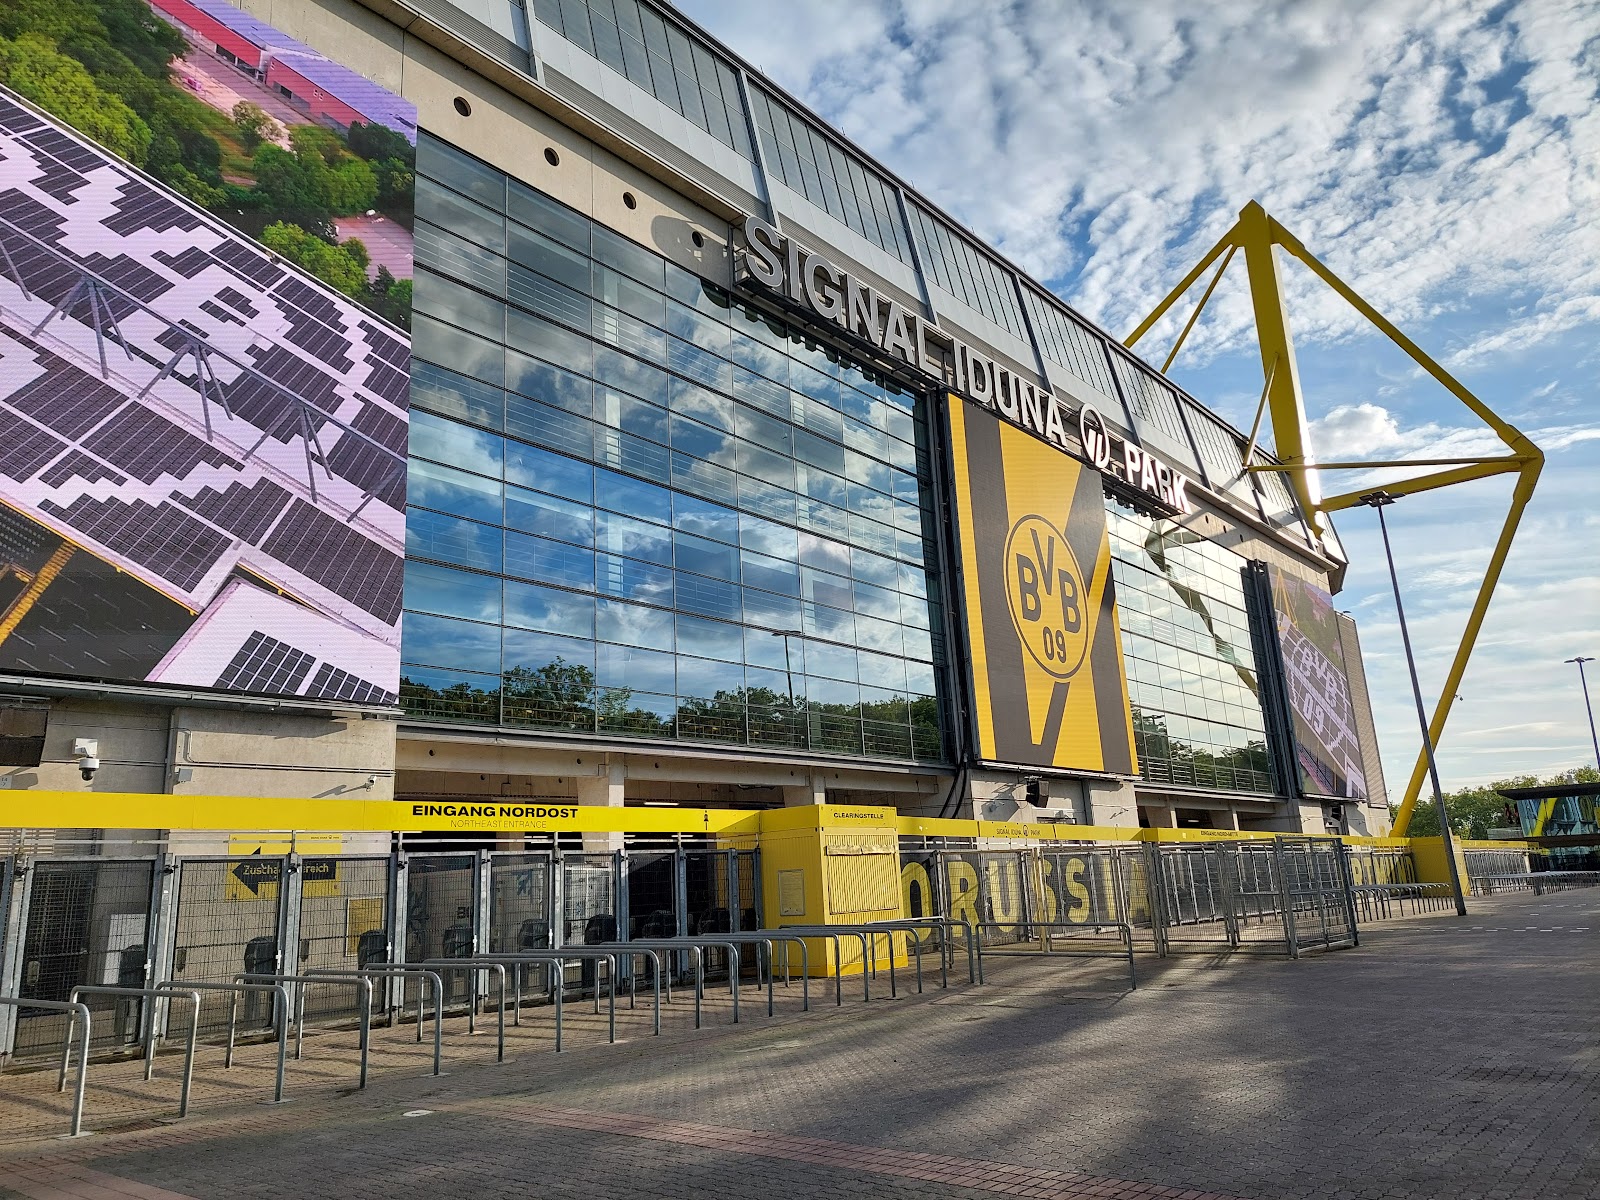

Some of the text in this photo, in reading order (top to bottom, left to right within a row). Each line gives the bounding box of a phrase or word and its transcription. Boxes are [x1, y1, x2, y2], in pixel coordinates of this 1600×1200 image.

[742, 215, 1192, 514] SIGNAL IDUNA PARK
[1016, 527, 1082, 634] BVB
[1042, 625, 1067, 664] 09
[1300, 646, 1338, 708] BVB
[1303, 692, 1325, 735] 09
[412, 805, 496, 817] EINGANG
[500, 806, 579, 818] NORDOST
[450, 819, 547, 829] NORTHEAST ENTRANCE
[833, 812, 884, 820] CLEARINGSTELLE
